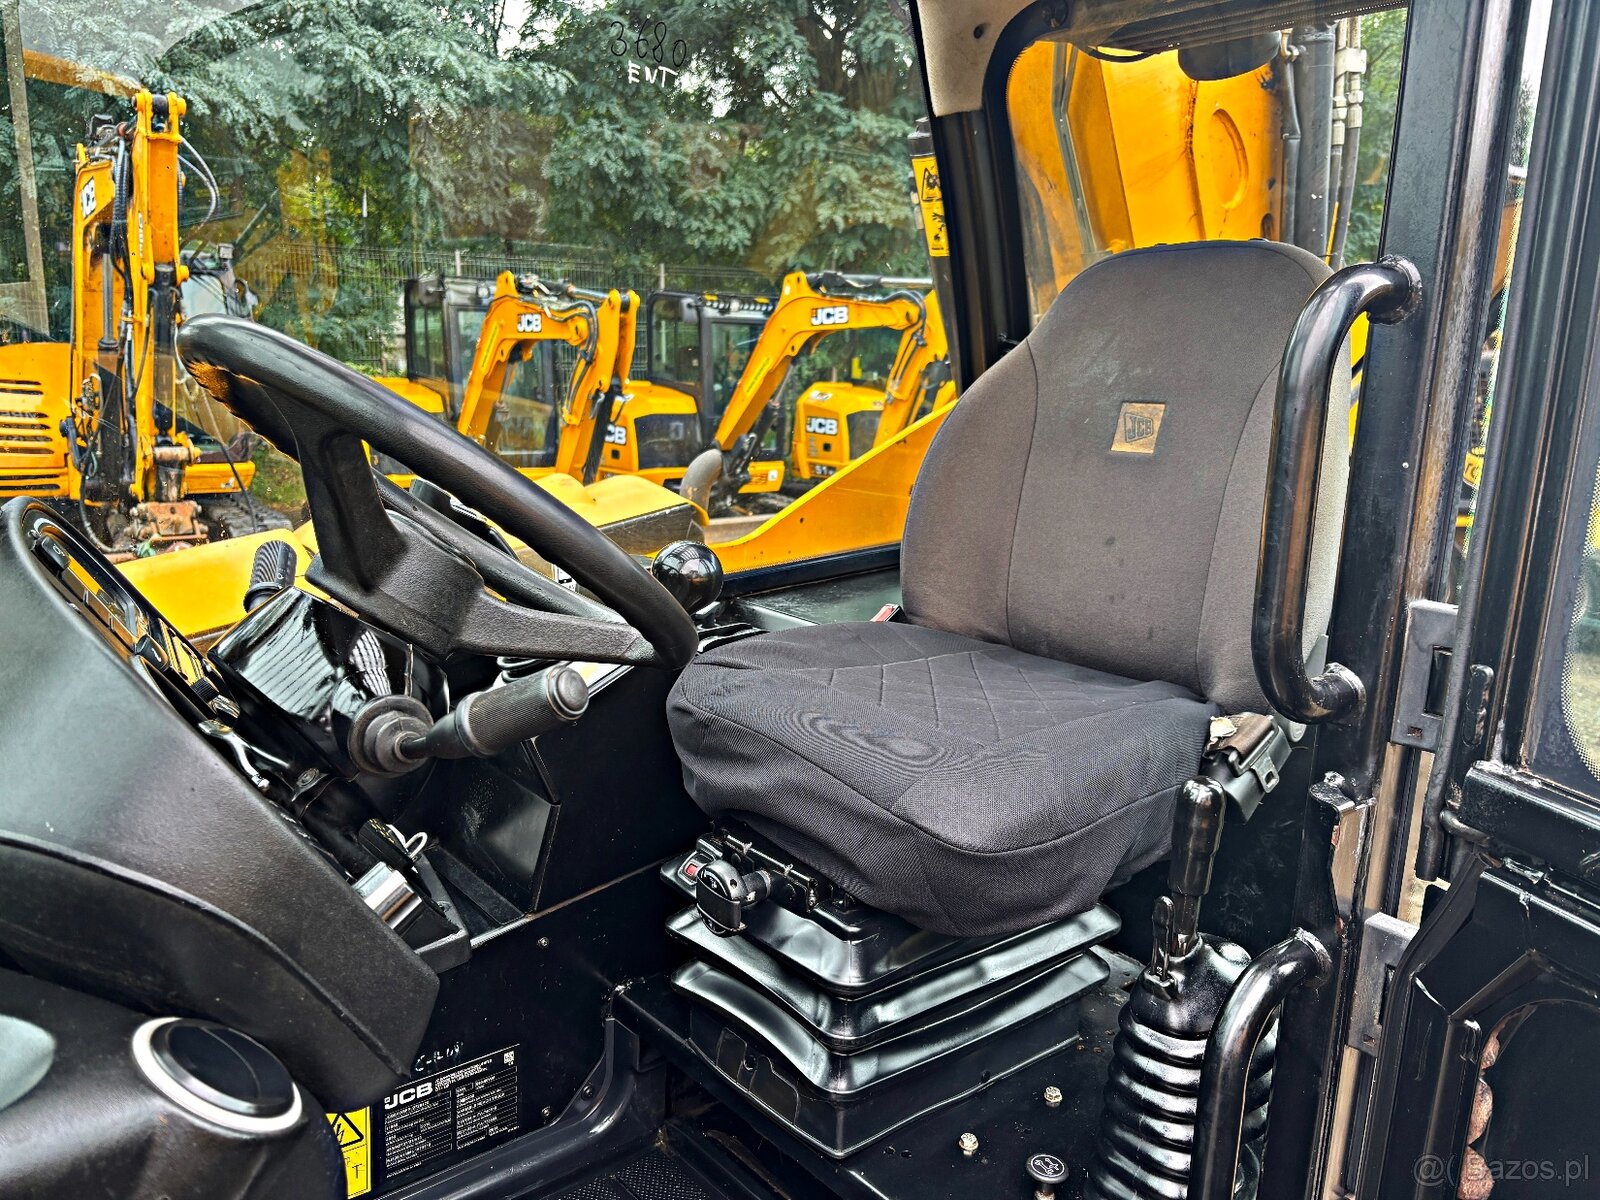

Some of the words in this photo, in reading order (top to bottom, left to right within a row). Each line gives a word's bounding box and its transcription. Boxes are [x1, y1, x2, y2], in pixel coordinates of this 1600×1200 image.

[627, 60, 679, 88] ENT
[517, 313, 542, 333] JCB
[811, 306, 849, 326] JCB
[604, 424, 627, 445] CB
[806, 416, 839, 435] JCB
[1126, 415, 1152, 440] JCB
[384, 1081, 433, 1110] JCB
